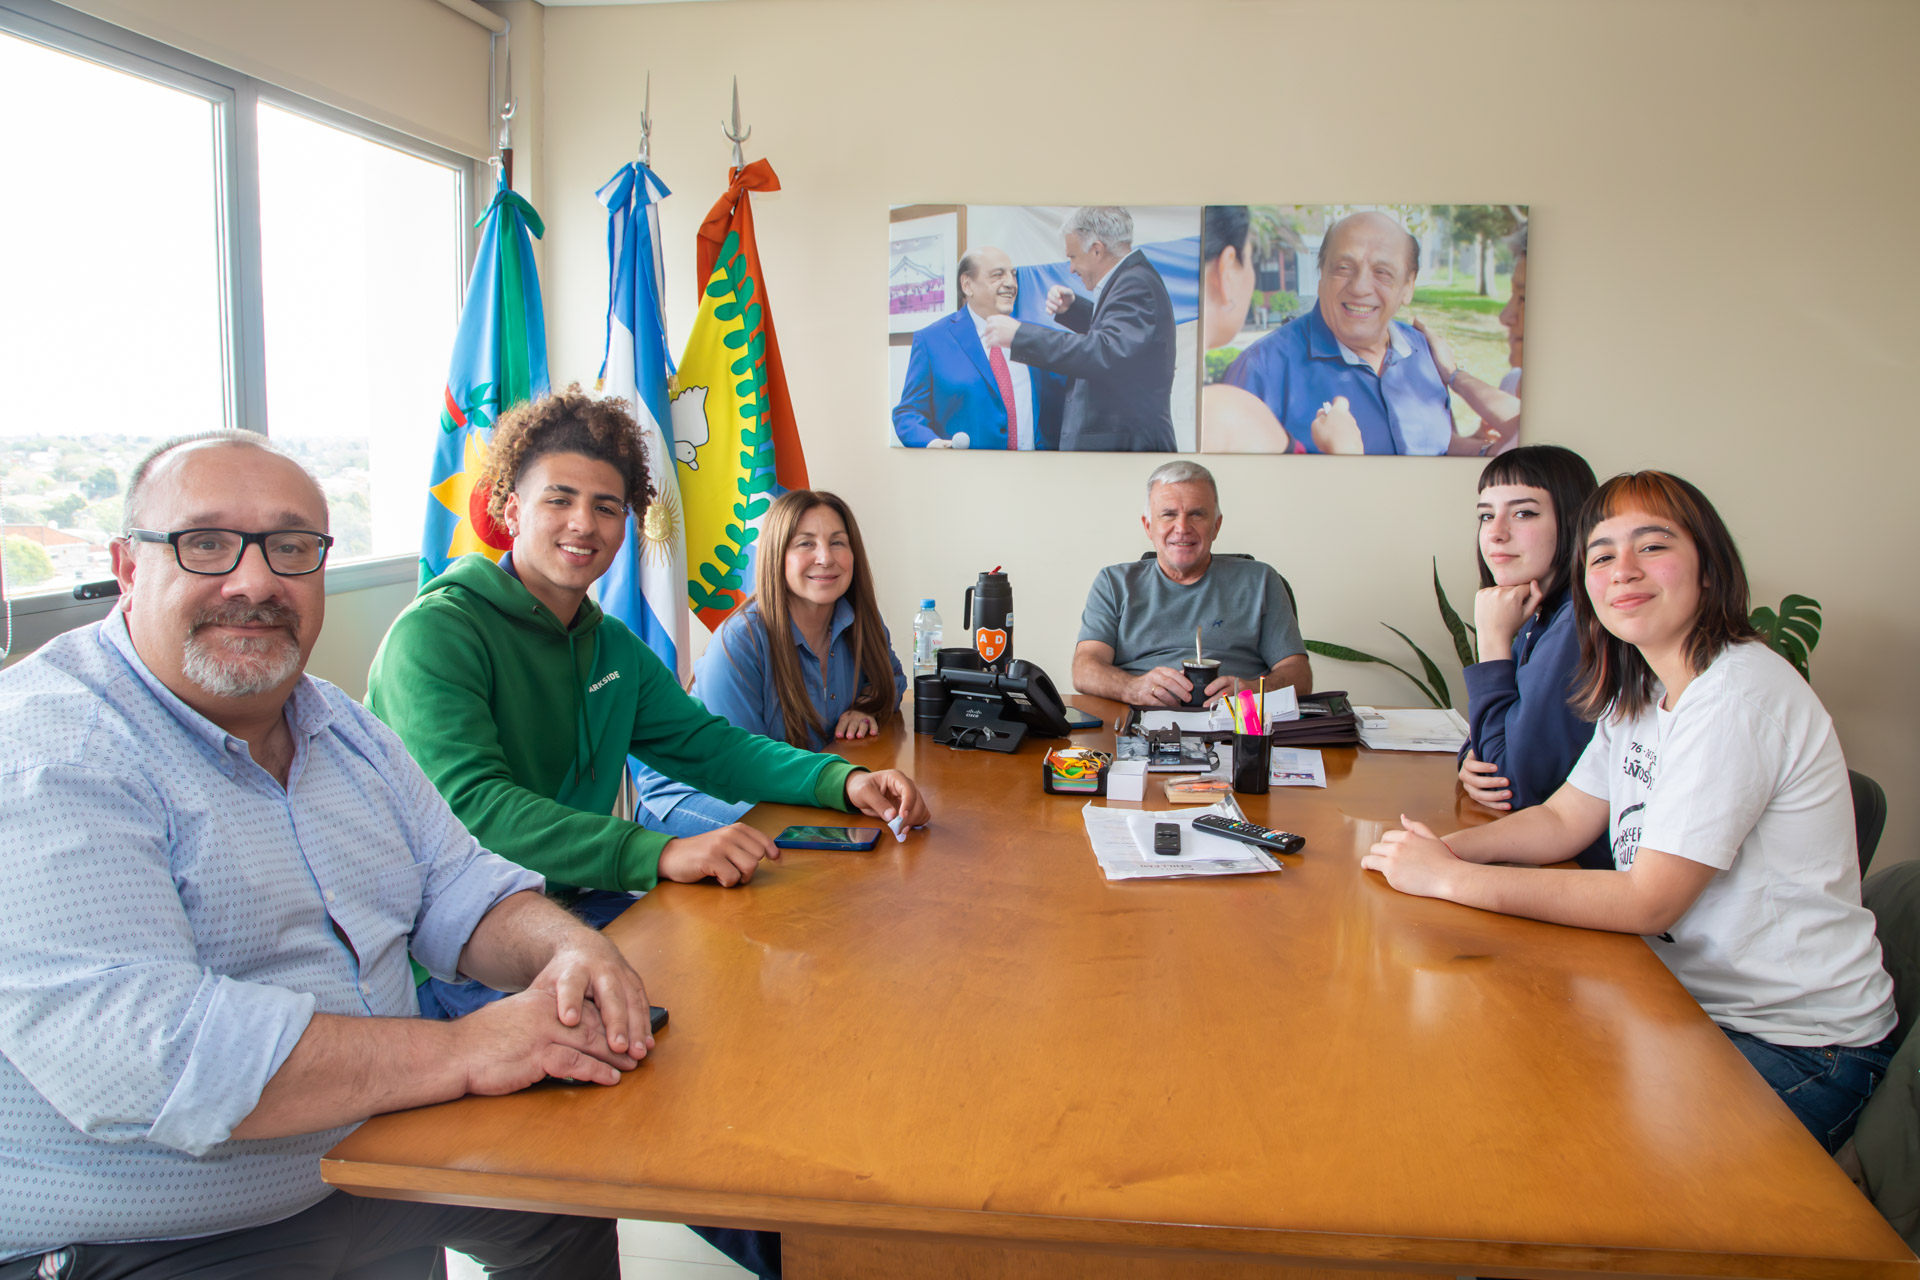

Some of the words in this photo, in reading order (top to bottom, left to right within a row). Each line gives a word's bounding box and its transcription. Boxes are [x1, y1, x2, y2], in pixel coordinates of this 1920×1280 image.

[979, 634, 987, 643] A
[995, 635, 1003, 644] D
[986, 647, 994, 656] B
